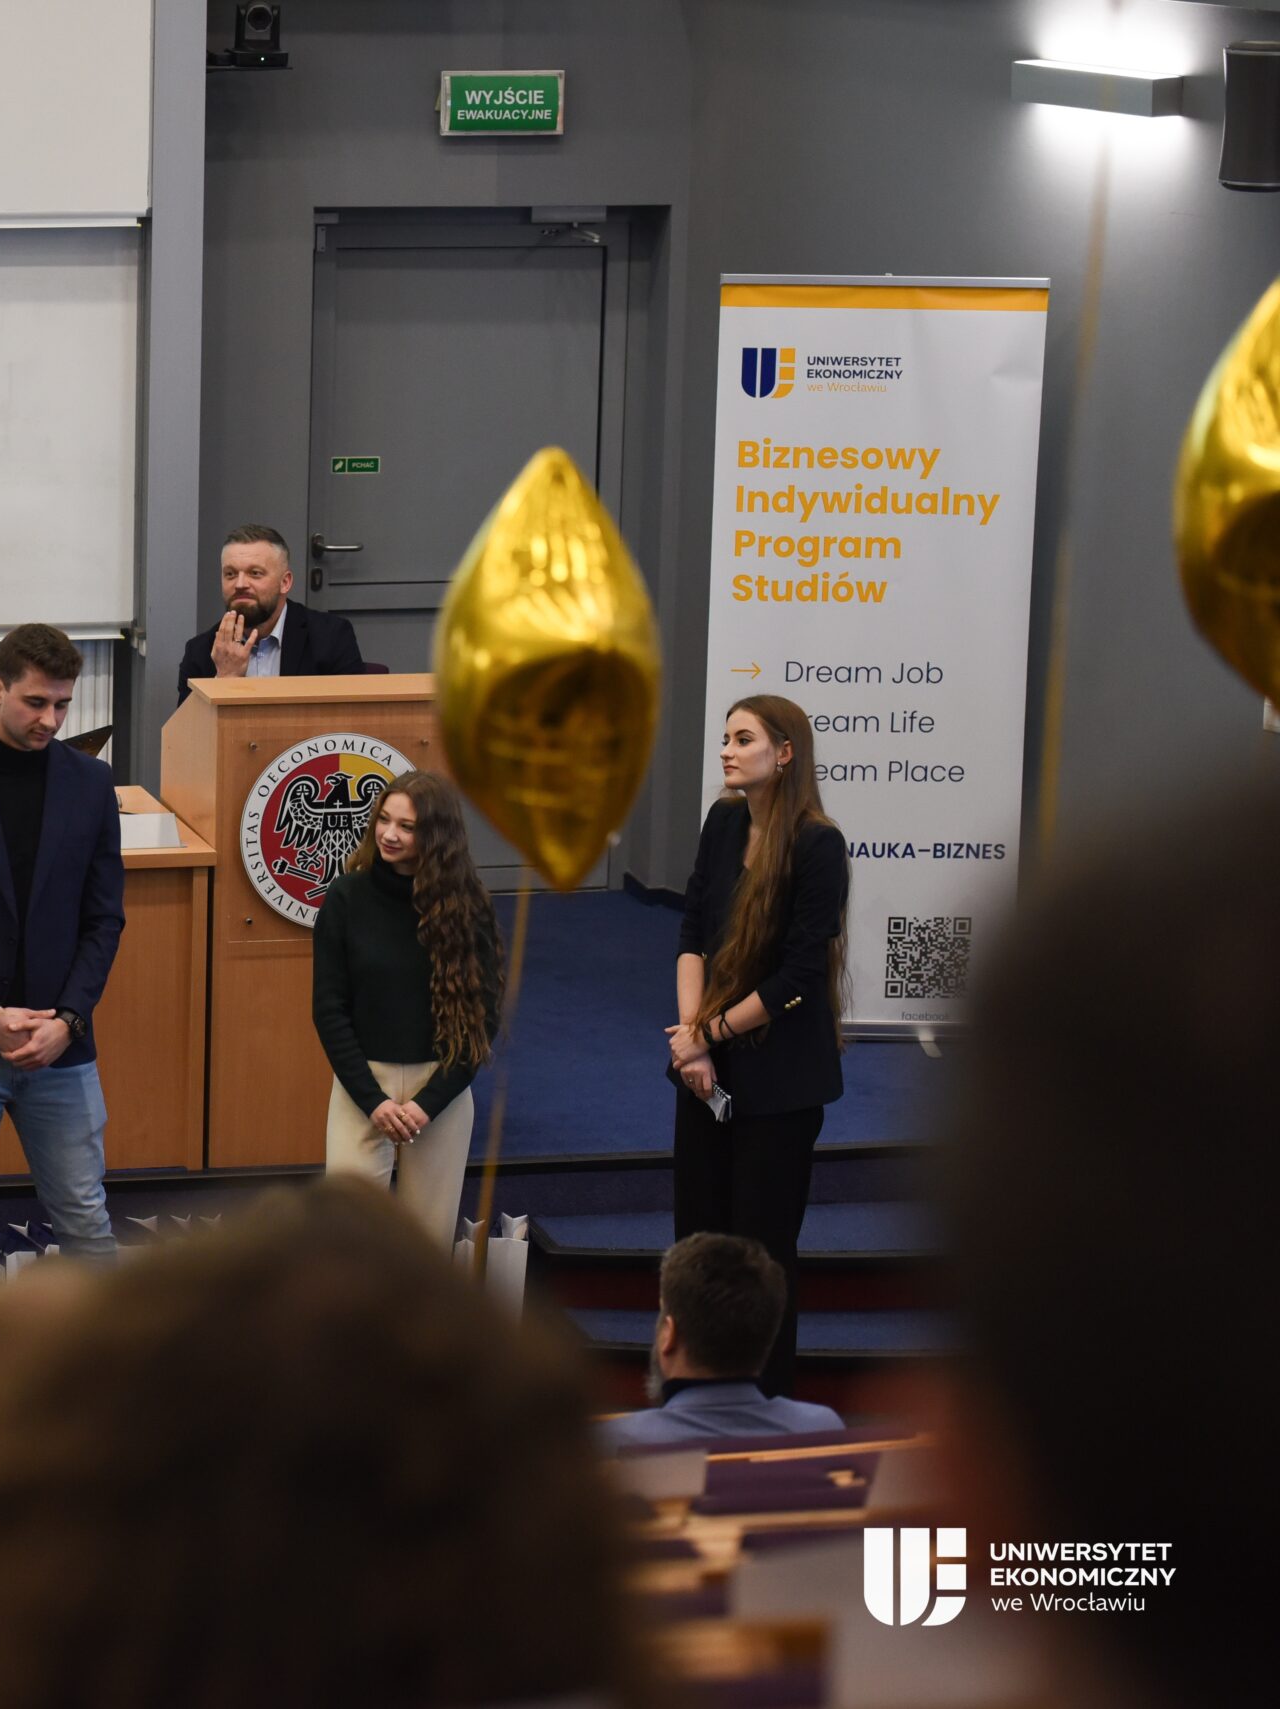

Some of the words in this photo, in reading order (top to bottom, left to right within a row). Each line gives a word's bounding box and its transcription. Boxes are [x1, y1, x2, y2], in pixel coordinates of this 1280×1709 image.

[465, 87, 545, 105] WYJŚCIE
[457, 109, 552, 120] EWAKUACYJNE
[807, 356, 902, 367] UNIWERSYTET
[806, 369, 903, 380] EKONOMICZNY
[807, 384, 823, 392] we
[827, 382, 887, 393] Wrocławiu
[737, 437, 941, 480] Biznesowy
[735, 483, 1001, 525] Indywidualny
[733, 529, 902, 568] Program
[731, 571, 888, 603] Studiów
[785, 661, 882, 683] Dream
[892, 661, 944, 684] Job
[807, 714, 880, 733] eam
[890, 710, 935, 733] Life
[257, 739, 393, 798] OECONOMICA
[815, 763, 877, 782] eam
[888, 760, 965, 783] Place
[326, 814, 349, 828] UE
